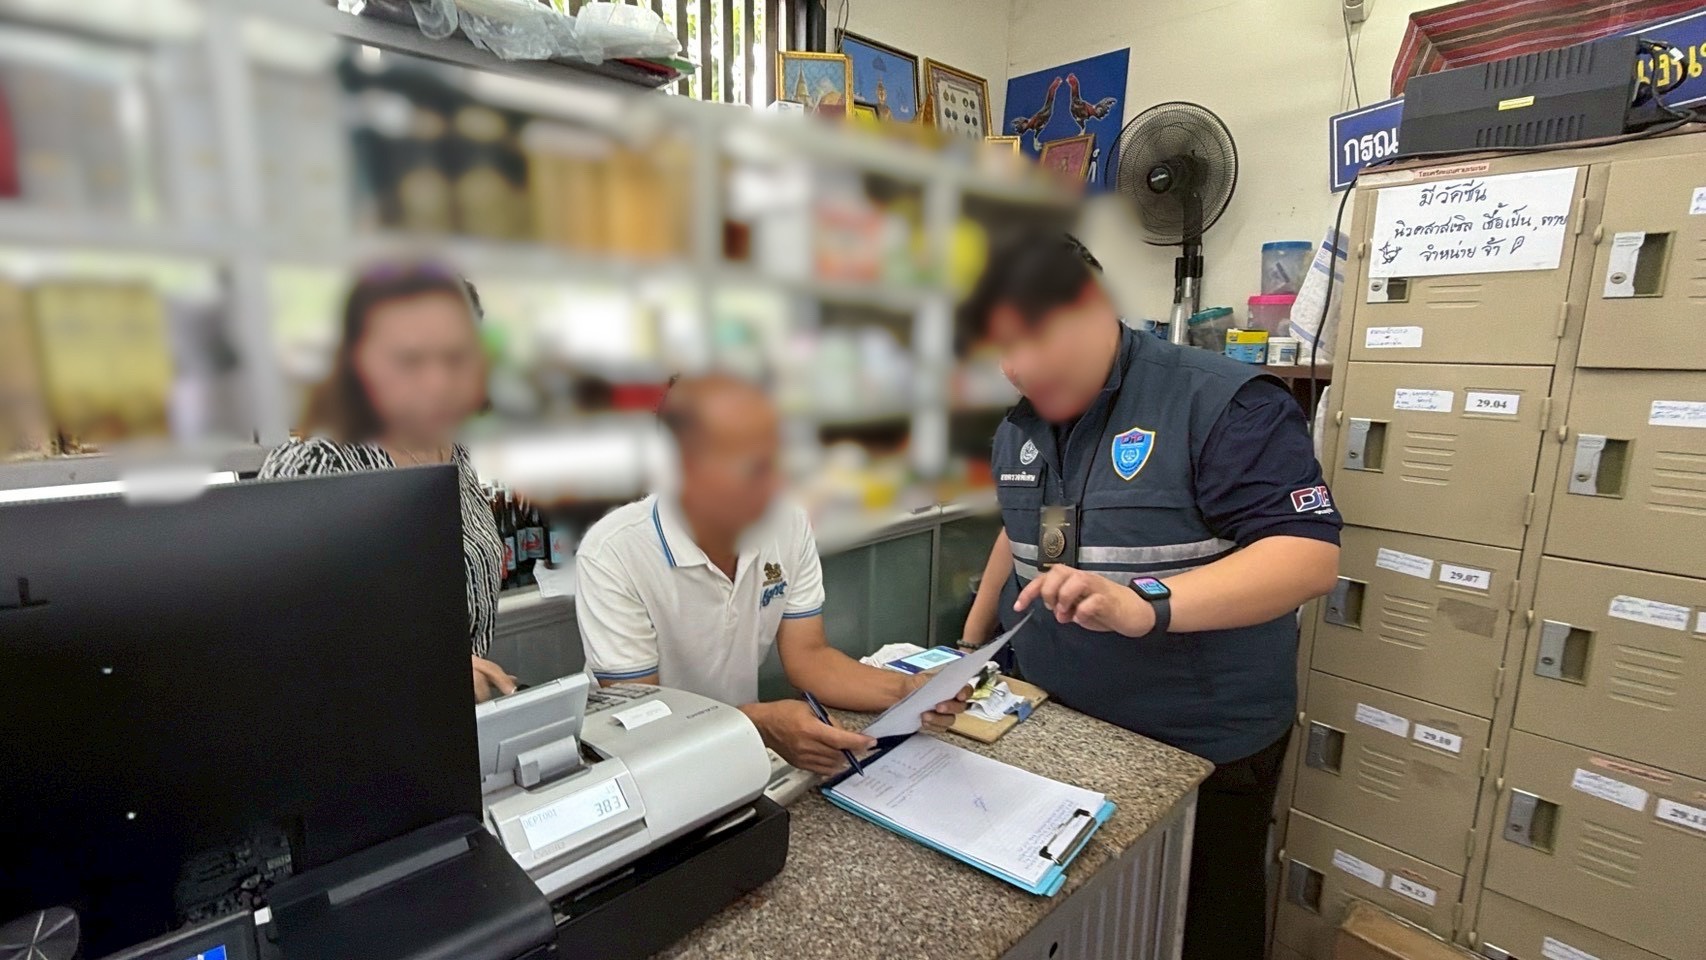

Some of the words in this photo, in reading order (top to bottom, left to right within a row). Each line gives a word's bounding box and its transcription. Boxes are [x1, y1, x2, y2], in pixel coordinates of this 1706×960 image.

[1476, 398, 1508, 409] 29.04
[1449, 570, 1480, 584] 29.07
[593, 795, 622, 817] 383
